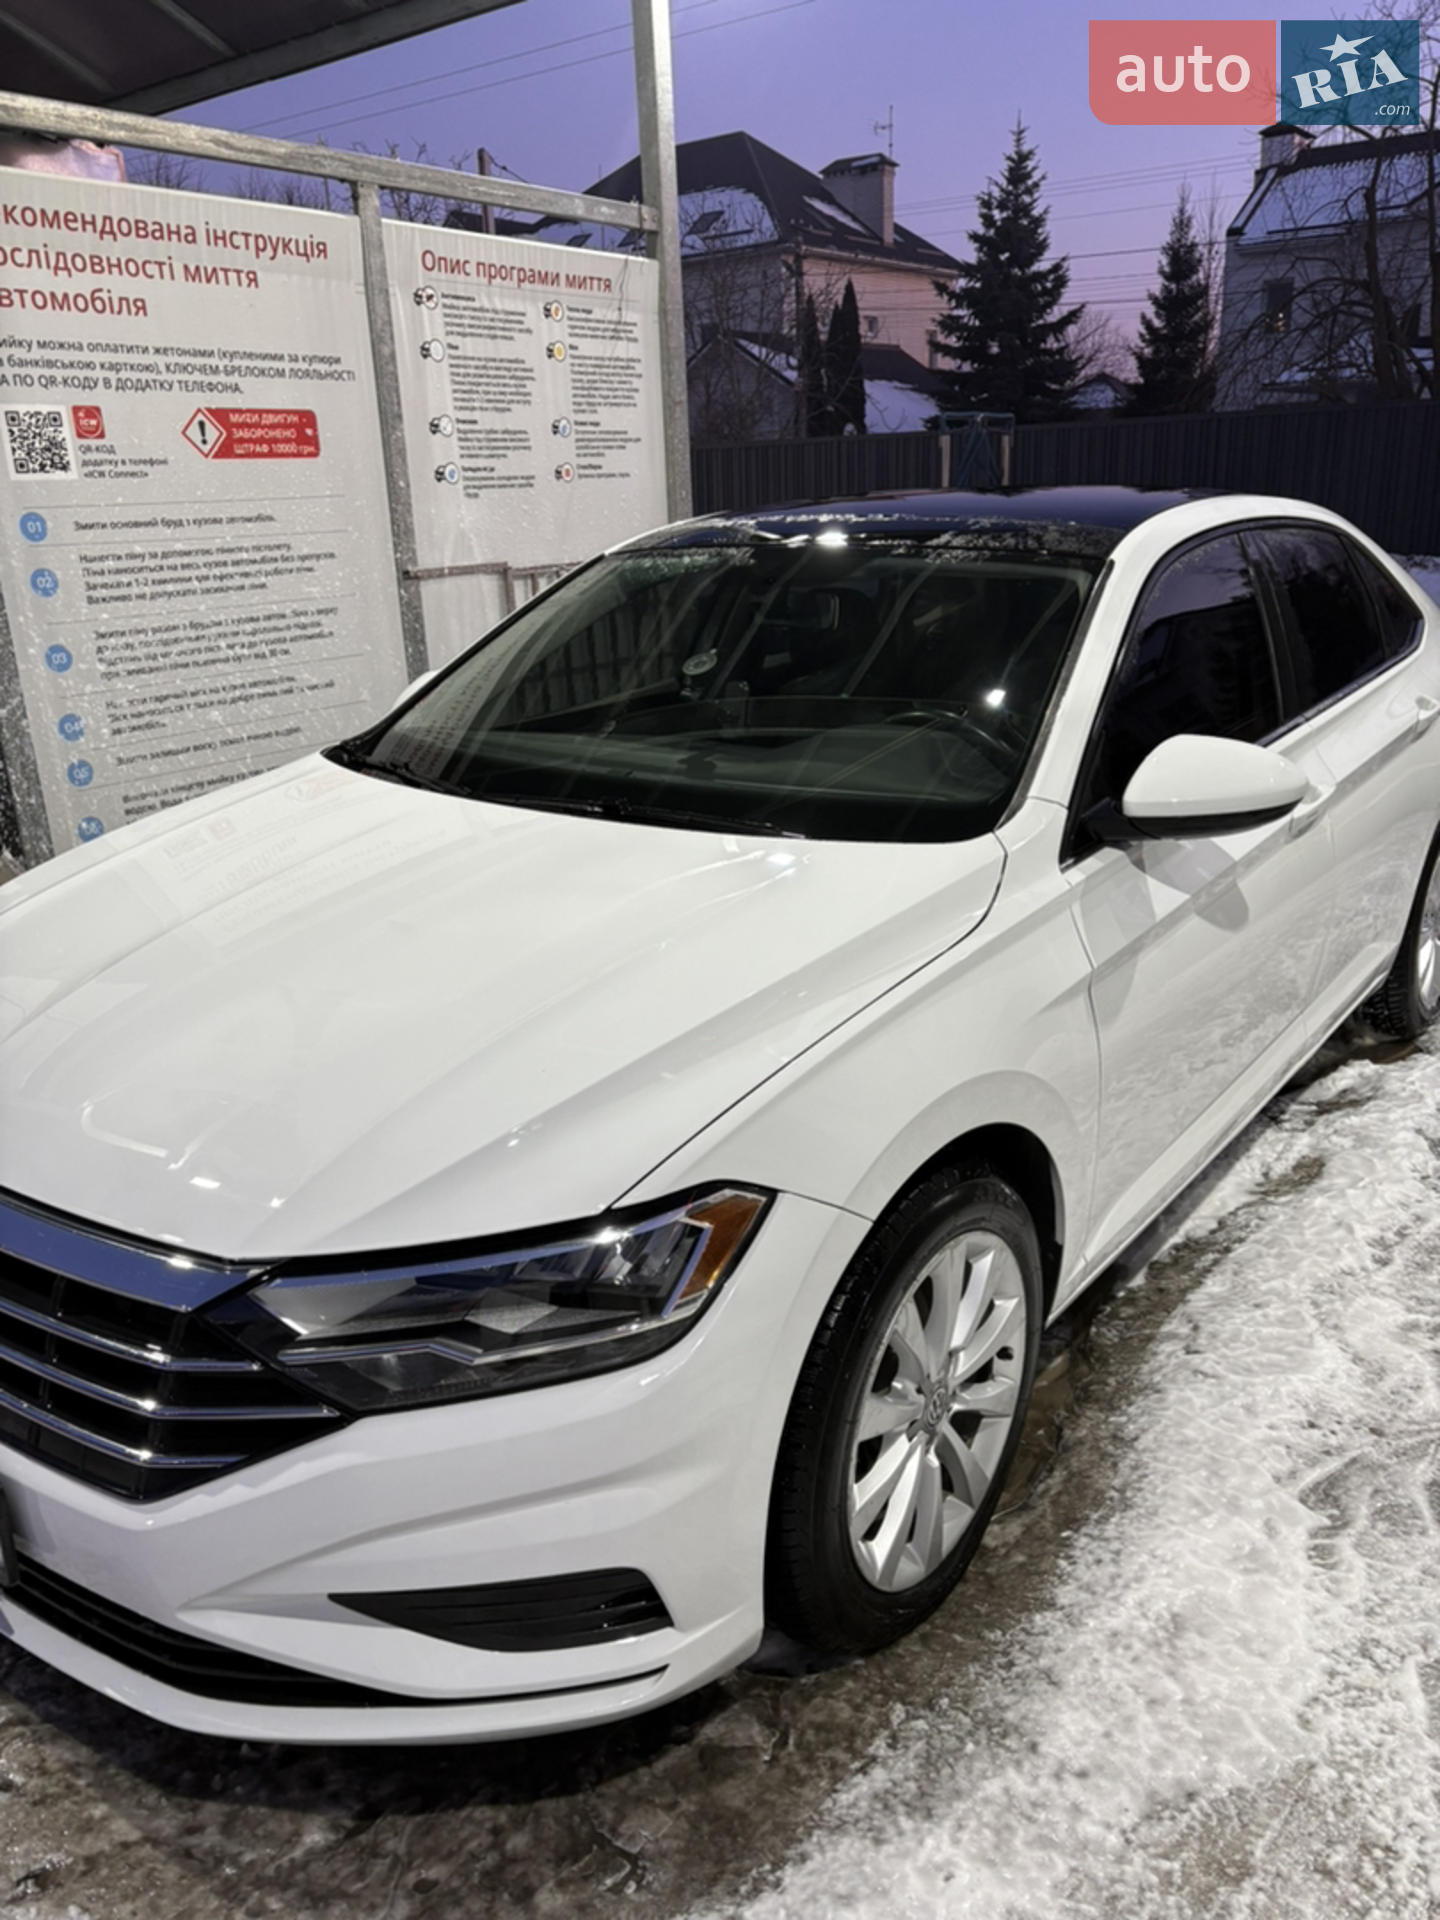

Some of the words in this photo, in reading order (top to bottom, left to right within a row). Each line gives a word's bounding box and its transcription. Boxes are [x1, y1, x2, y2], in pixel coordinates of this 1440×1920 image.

[0, 204, 197, 245] комендована
[205, 220, 328, 263] інструкція
[183, 263, 259, 289] миття
[421, 249, 471, 276] Опис
[476, 260, 560, 288] програми
[565, 273, 612, 293] миття
[0, 287, 148, 317] втомобіля
[36, 339, 84, 353] можна
[86, 342, 150, 356] оплатити
[152, 345, 215, 359] жетонами
[217, 347, 285, 363] (купленими
[287, 353, 299, 363] за
[302, 354, 341, 368] купюри
[6, 353, 97, 371] банківською
[165, 362, 286, 379] КЛЮЧЕМ-БРЕЛОКОМ
[288, 367, 356, 381] ЛОЯЛЬНОСТІ
[13, 374, 35, 388] ПО
[38, 374, 99, 391] QR-КОДУ
[103, 377, 112, 390] В
[115, 377, 175, 393] ДОДАТКУ
[231, 427, 297, 439] ЗАБОРОНЕНО
[233, 443, 270, 455] ШТРАФ
[27, 520, 42, 533] 01
[74, 520, 108, 532] Змити
[110, 517, 159, 529] основний
[161, 516, 185, 530] бруд
